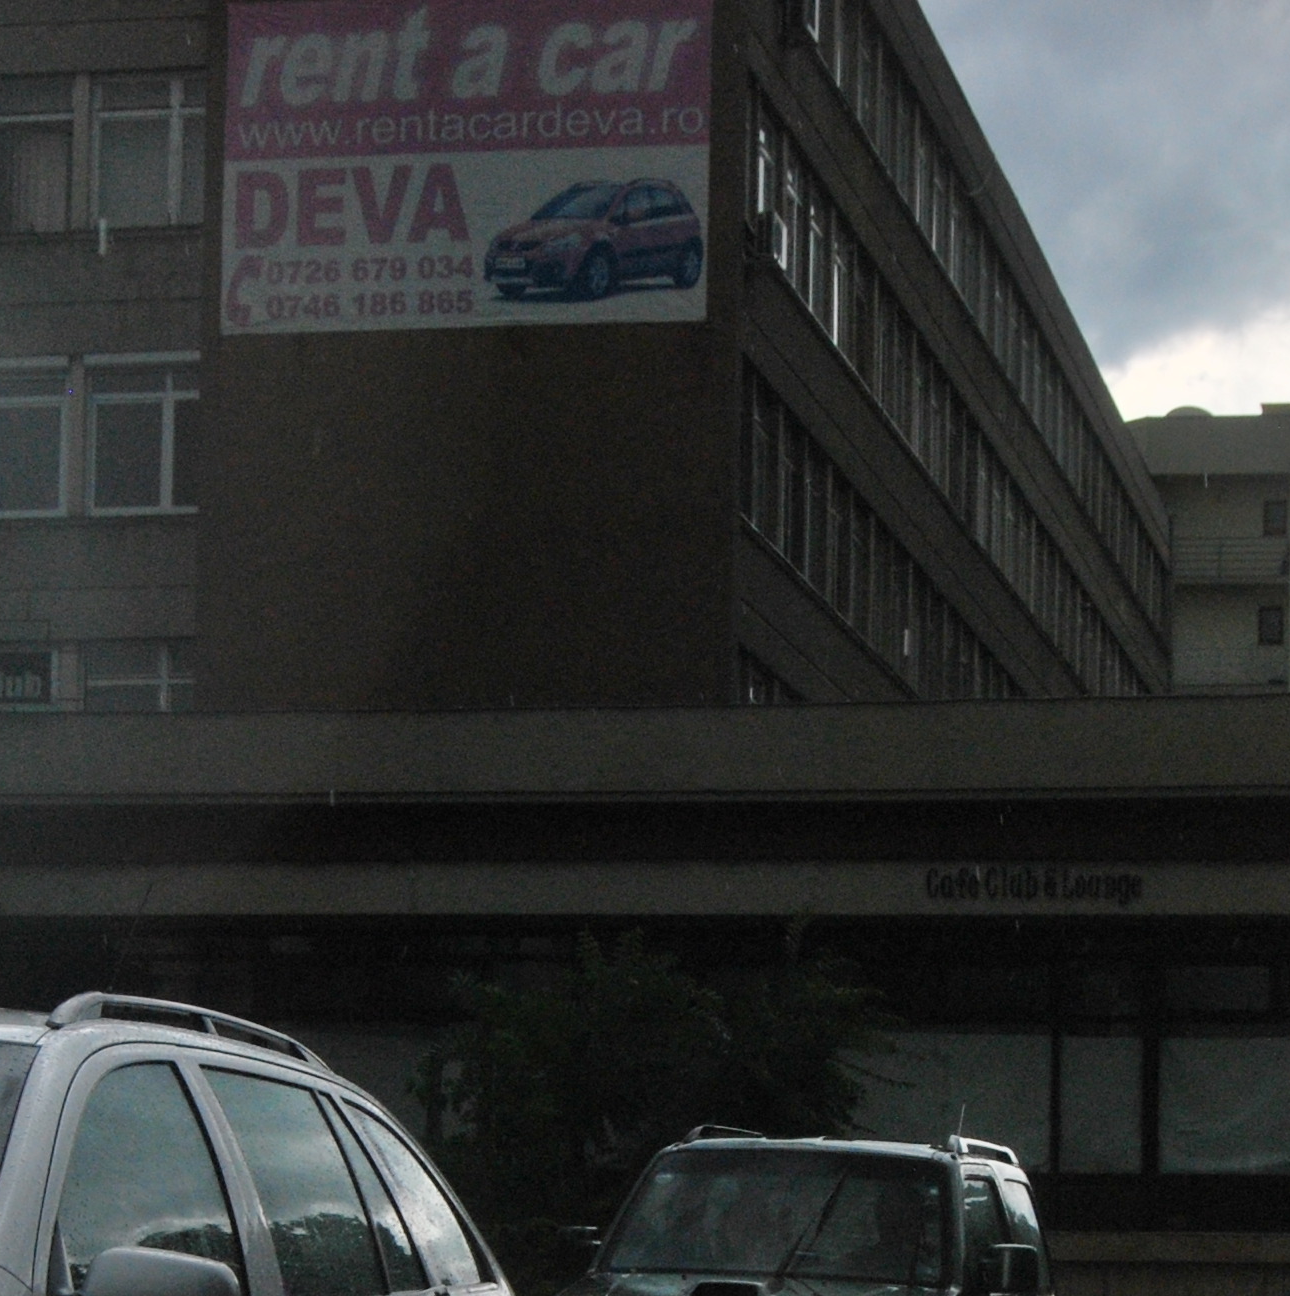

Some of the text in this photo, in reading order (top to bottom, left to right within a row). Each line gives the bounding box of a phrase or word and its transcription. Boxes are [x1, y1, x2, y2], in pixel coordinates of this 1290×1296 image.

[241, 6, 699, 104] rent a car
[238, 103, 705, 150] www.rentacardeva.ro
[234, 163, 471, 249] DEVA
[267, 254, 474, 285] 0726 679 034
[266, 293, 341, 320] 0746
[351, 291, 407, 317] 186
[985, 866, 1039, 900] Club
[1061, 866, 1144, 907] Lounge
